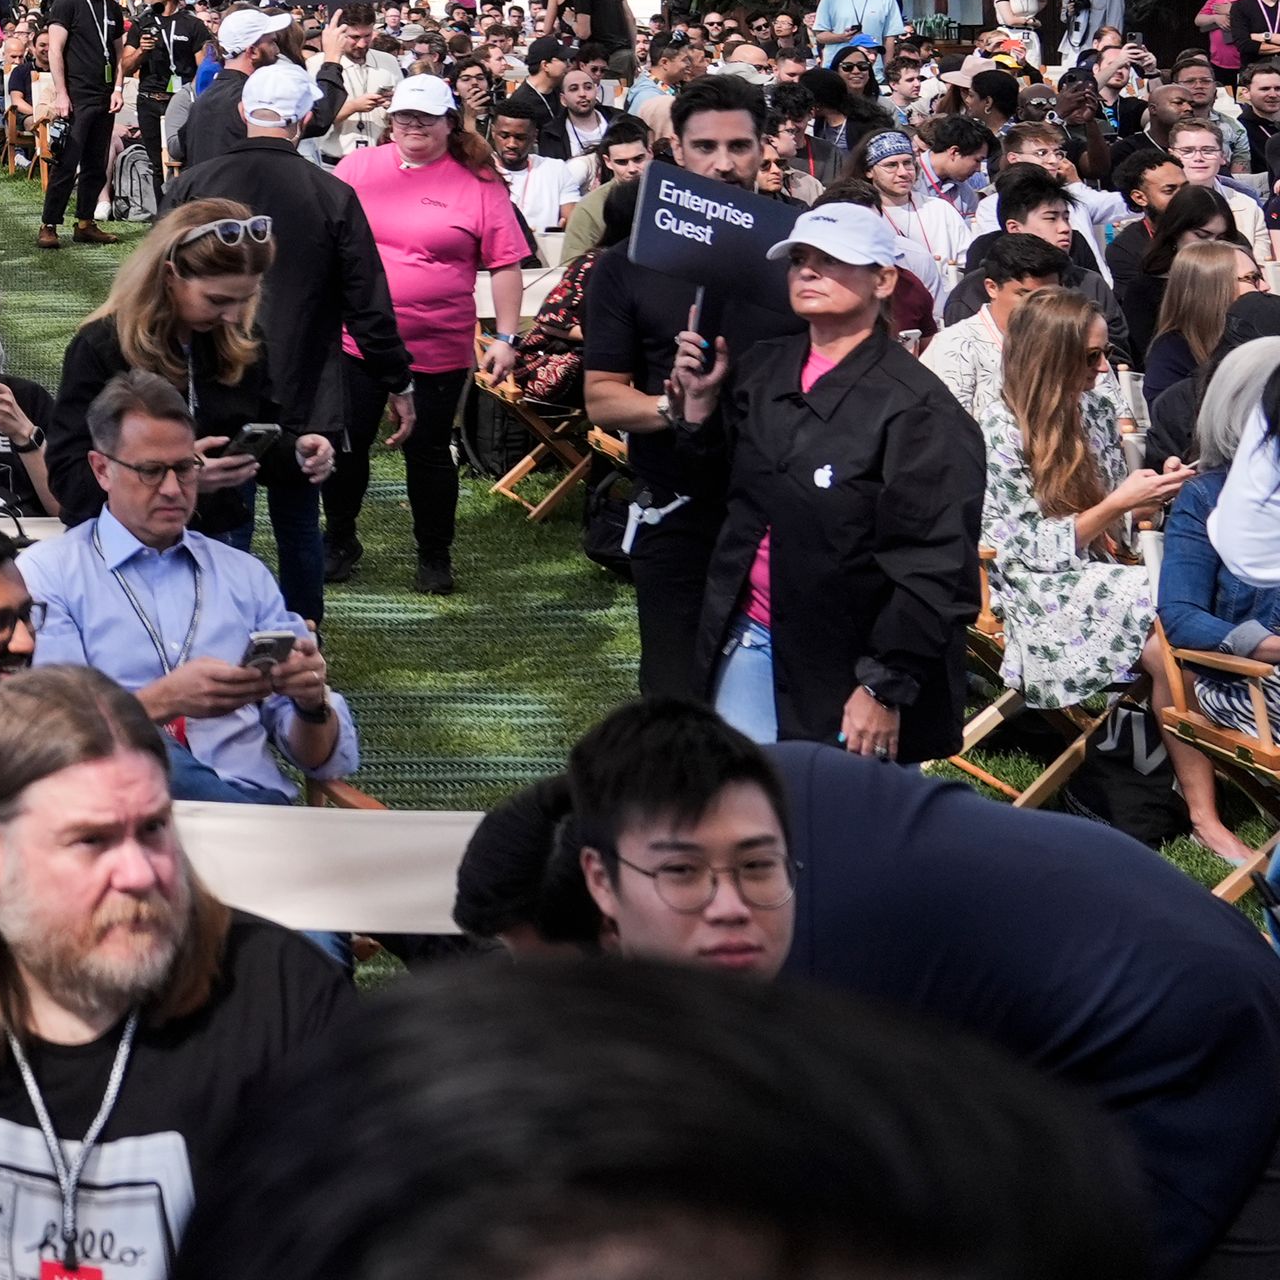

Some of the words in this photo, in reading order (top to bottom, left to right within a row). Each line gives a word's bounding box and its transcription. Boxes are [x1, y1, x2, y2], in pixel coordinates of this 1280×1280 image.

[654, 208, 714, 246] Guest
[658, 179, 755, 229] Enterprise
[24, 1220, 146, 1267] hllo
